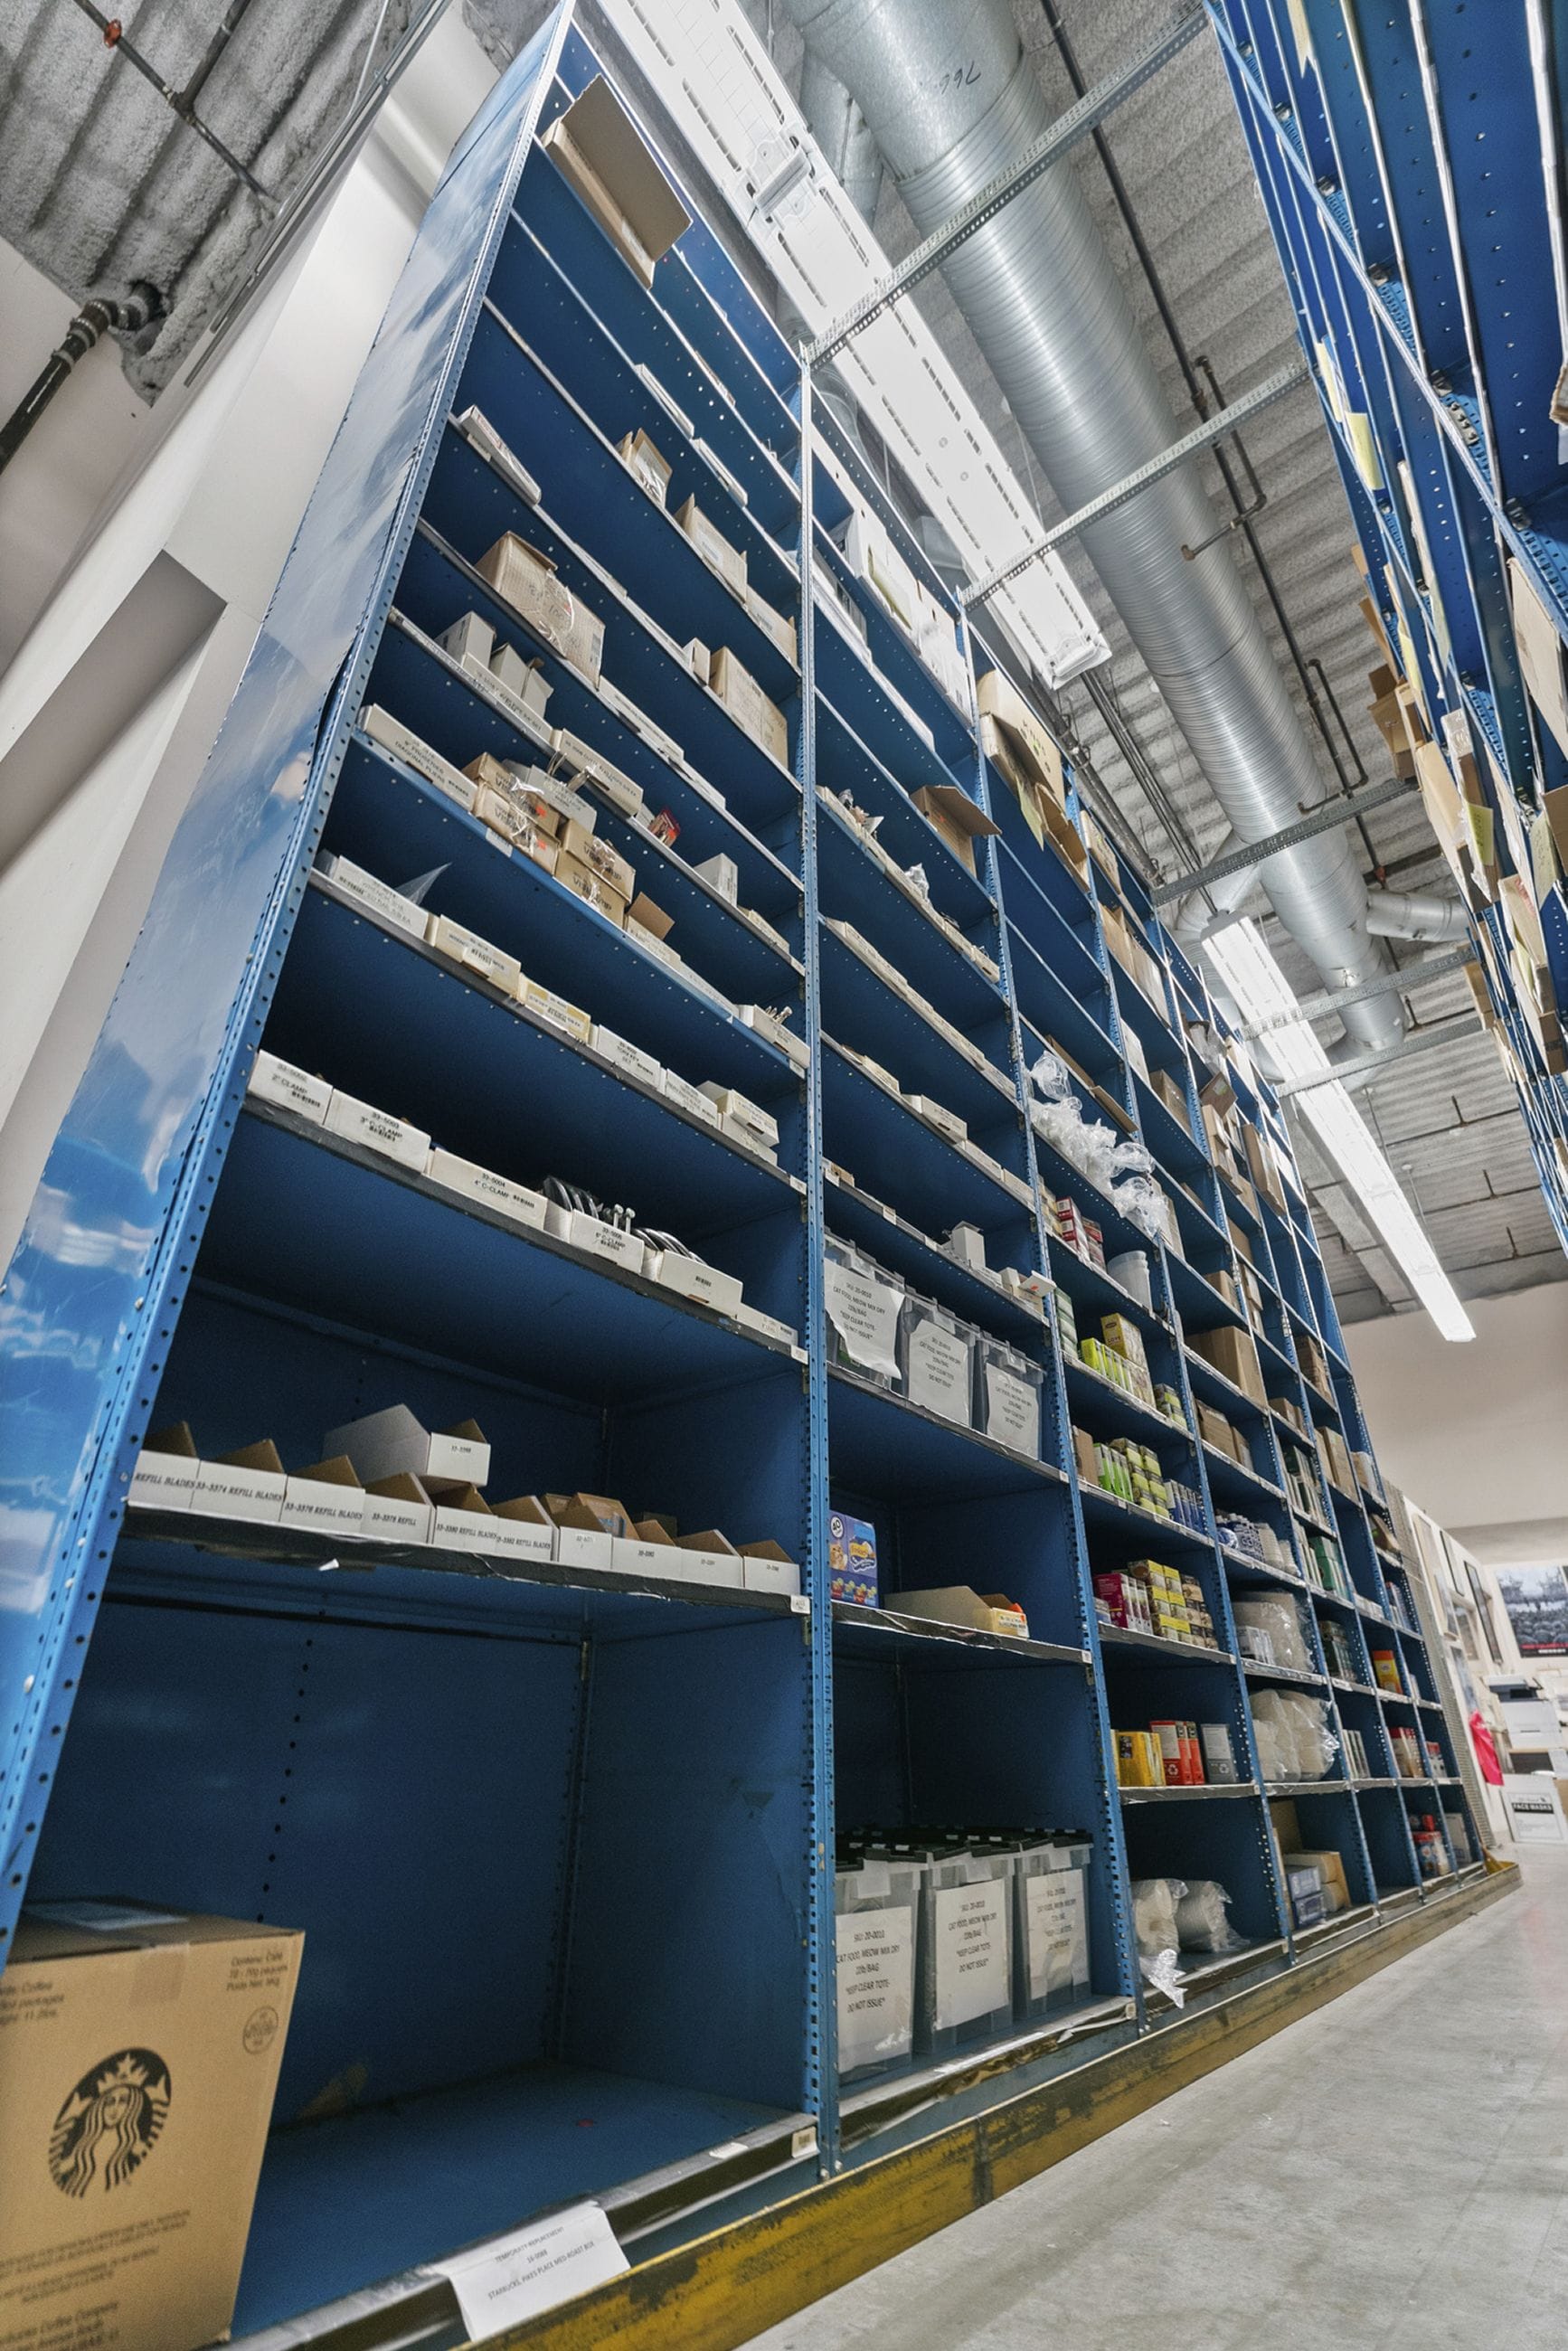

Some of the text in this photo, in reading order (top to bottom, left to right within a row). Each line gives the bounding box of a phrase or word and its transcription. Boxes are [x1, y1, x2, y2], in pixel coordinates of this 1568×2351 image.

[482, 1183, 509, 1199] C-CLAMP
[135, 1472, 195, 1489] REFILL BLADES
[228, 1487, 253, 1498] REFILL
[255, 1491, 282, 1502] BLADES
[314, 1506, 337, 1517] REFILL
[338, 1510, 363, 1520] BLADES
[397, 1516, 417, 1526] REFILL
[458, 1526, 477, 1536] REFILL
[477, 1530, 497, 1539] BLADES
[515, 1538, 532, 1547] REFILL
[533, 1541, 552, 1550] BLADES
[537, 2262, 554, 2276] PLACE
